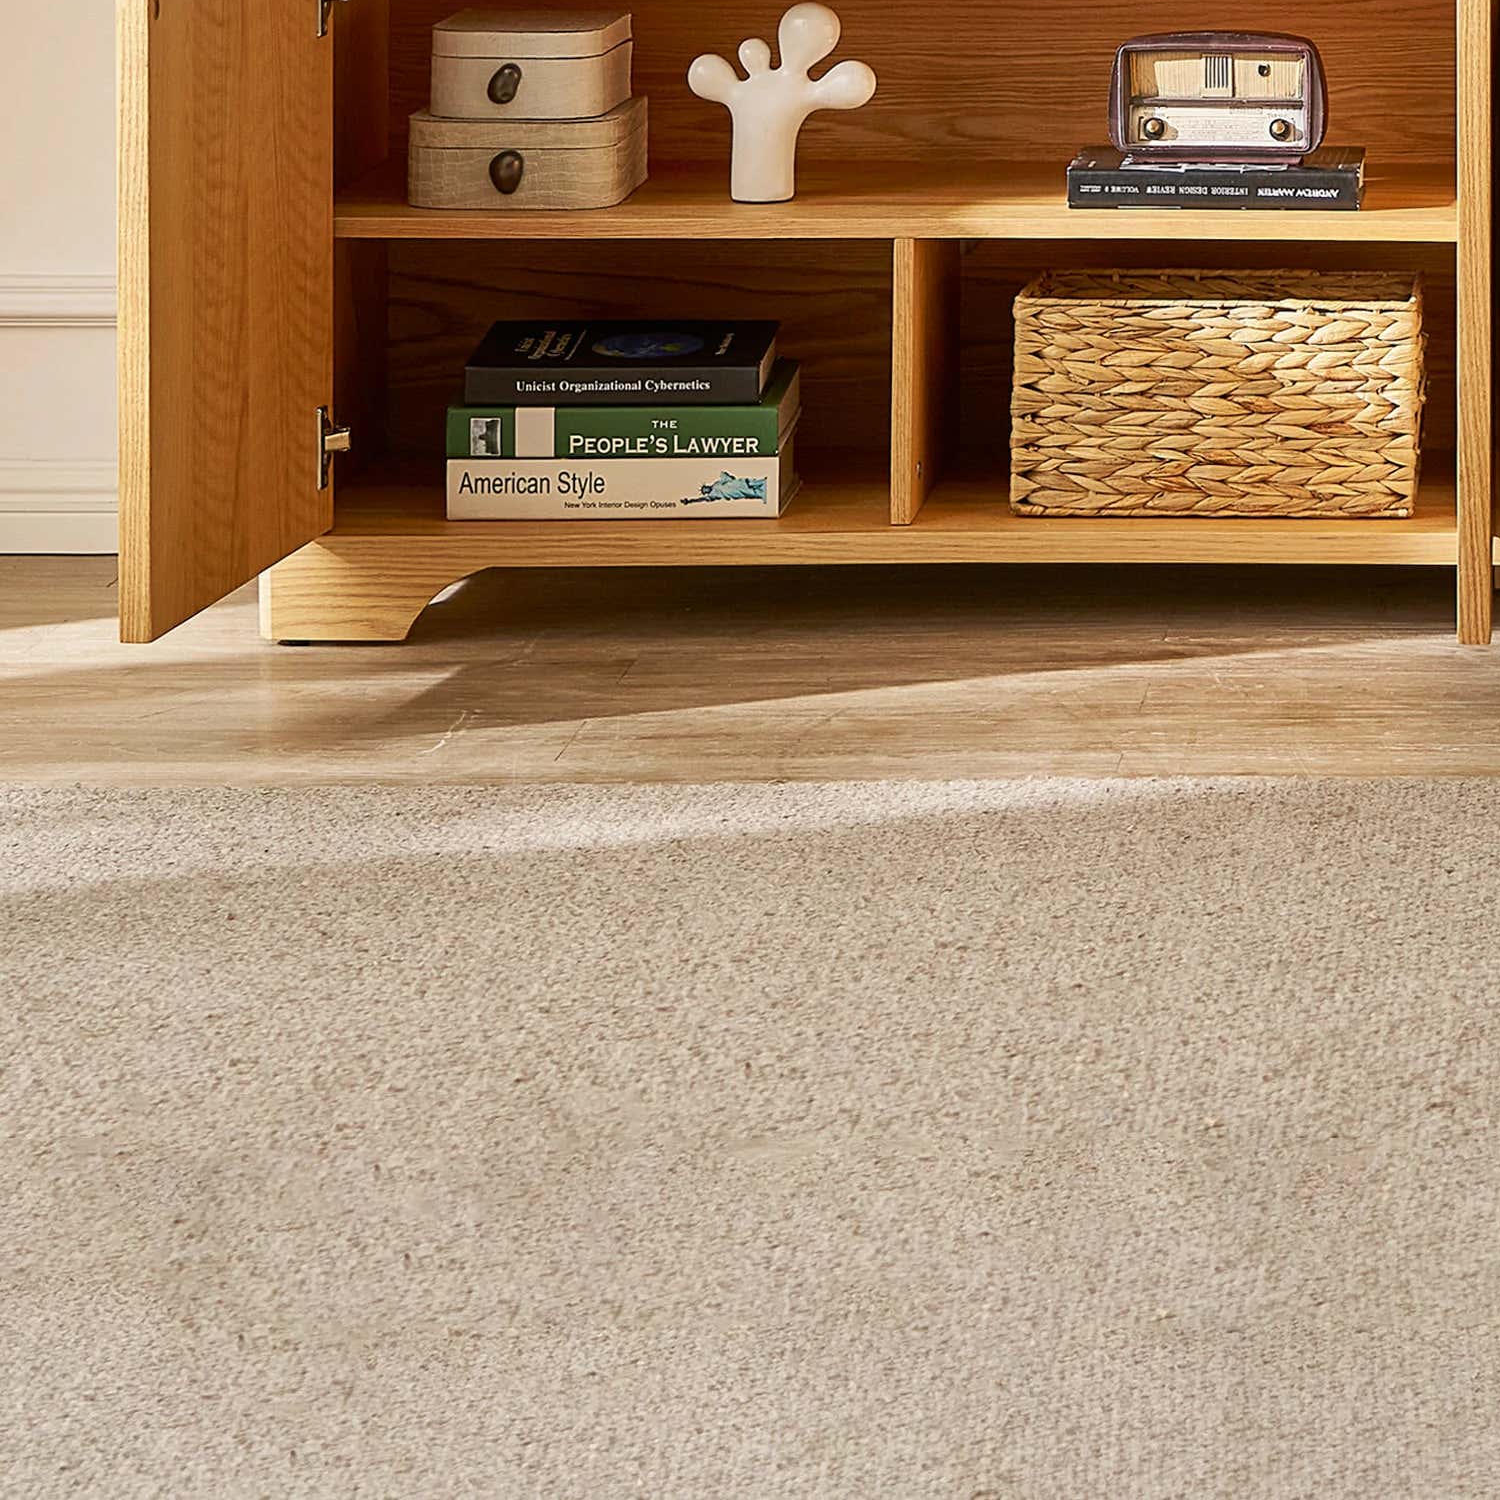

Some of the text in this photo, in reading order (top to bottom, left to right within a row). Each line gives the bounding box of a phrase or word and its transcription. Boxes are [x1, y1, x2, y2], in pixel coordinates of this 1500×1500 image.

[1146, 185, 1176, 195] REVIEW
[1178, 186, 1208, 195] DESIGN
[1210, 186, 1249, 197] INTERIOR
[516, 378, 711, 393] Unicist Organizational Cybernetics
[651, 419, 678, 430] THE
[569, 434, 760, 454] PEOPLE'S LAWYER
[458, 471, 606, 500] American Style
[563, 500, 677, 510] New York Interior Design Opuses
